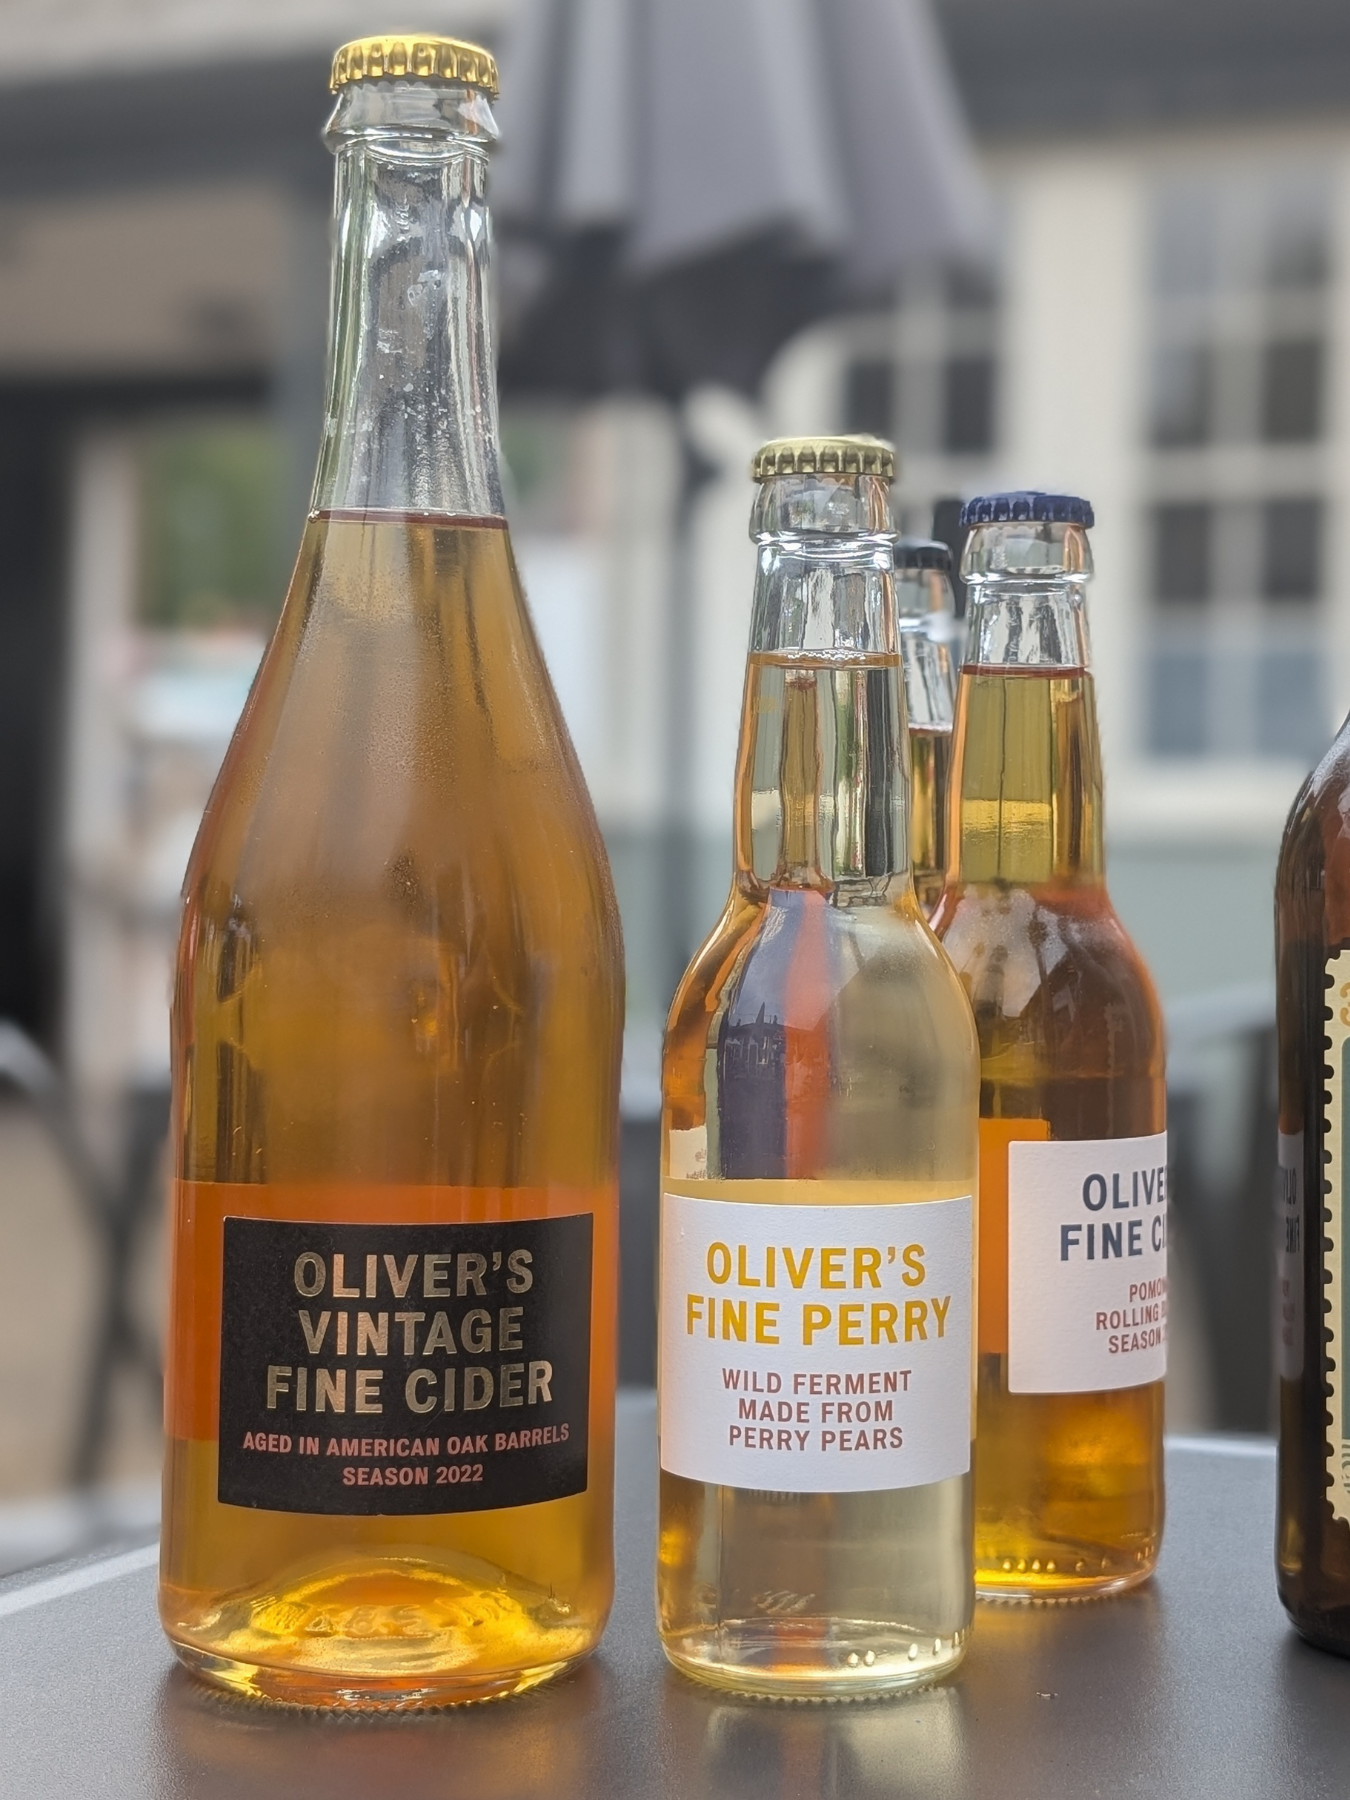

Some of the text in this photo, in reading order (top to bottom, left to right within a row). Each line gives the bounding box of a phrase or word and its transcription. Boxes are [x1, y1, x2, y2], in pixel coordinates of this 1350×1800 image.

[1060, 1219, 1143, 1261] FINE
[294, 1249, 534, 1298] OLIVER’S
[706, 1241, 926, 1289] OLIVER’S
[298, 1307, 524, 1356] VINTAGE
[686, 1293, 952, 1346] FINE PERRY
[1096, 1303, 1159, 1331] ROLLING
[1108, 1326, 1162, 1354] SEASON
[266, 1360, 553, 1414] FINE CIDER
[722, 1367, 912, 1395] WILD FERMENT
[738, 1398, 893, 1423] MADE FROM
[243, 1423, 570, 1457] AGED IN AMERICAN OAK BARRELS
[729, 1425, 904, 1451] PERRY PEARS
[342, 1464, 484, 1486] SEASON 2022
